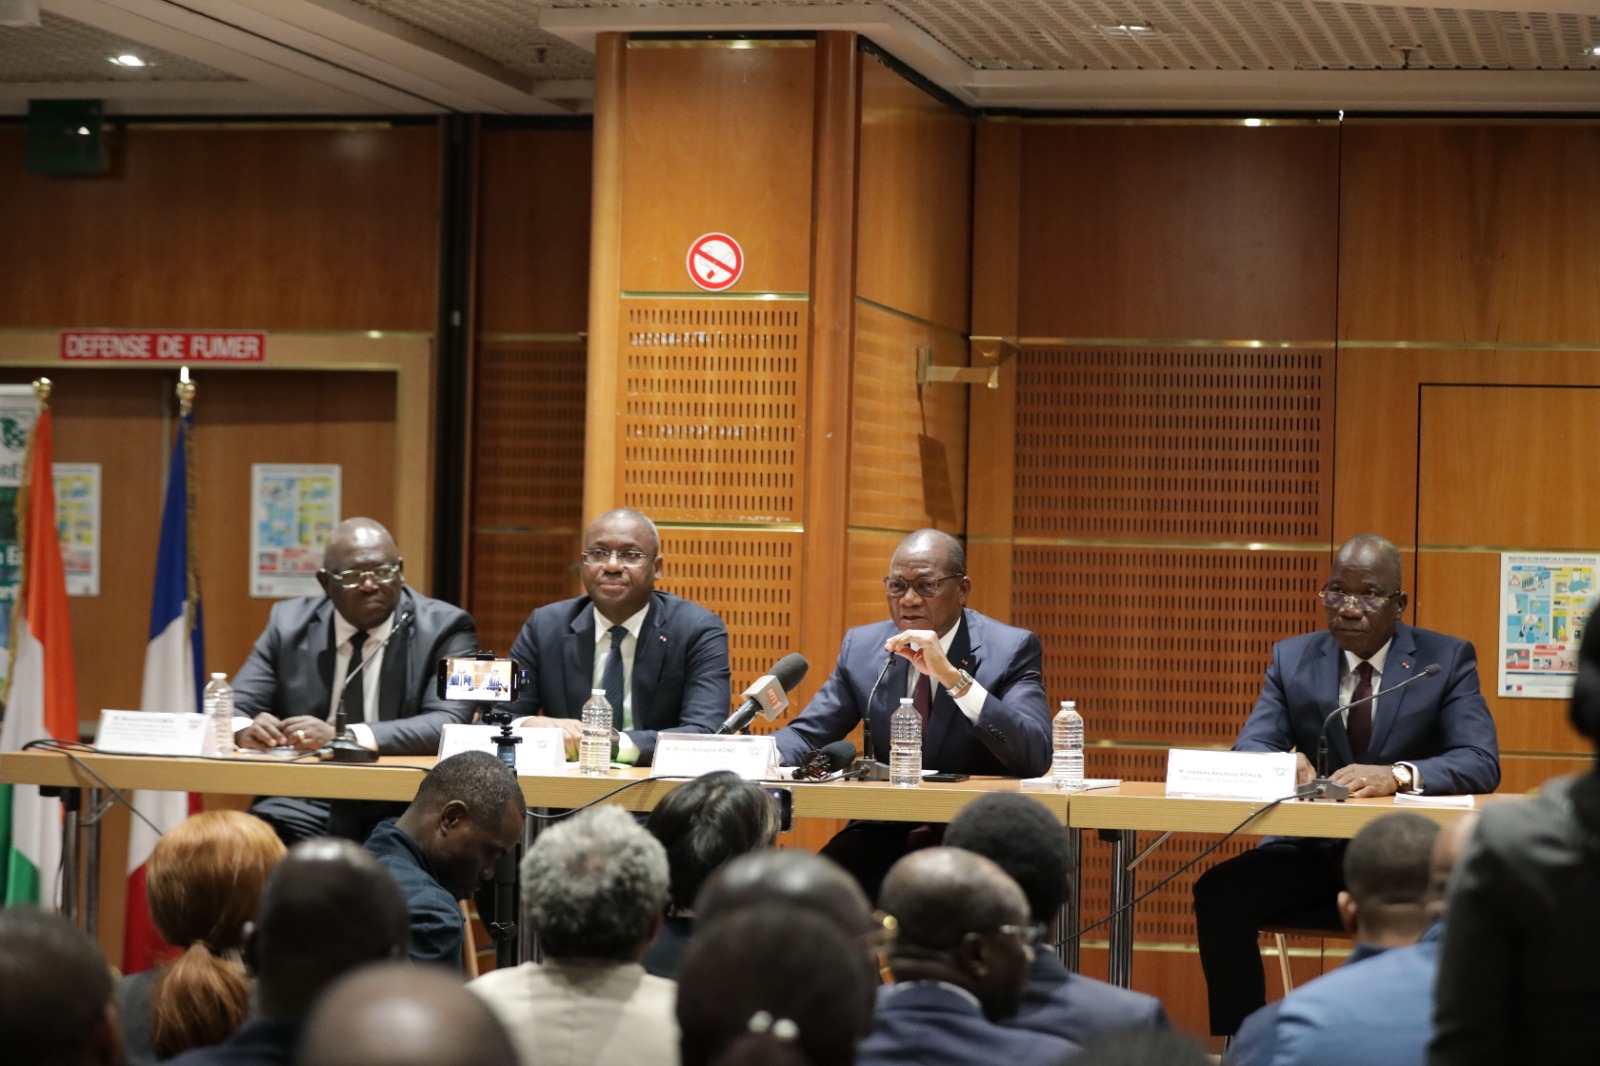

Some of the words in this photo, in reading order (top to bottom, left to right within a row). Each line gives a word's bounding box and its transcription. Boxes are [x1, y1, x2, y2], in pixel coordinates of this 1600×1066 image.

[65, 334, 151, 358] DEFENSE
[157, 335, 185, 359] DE
[190, 336, 260, 359] FUMER
